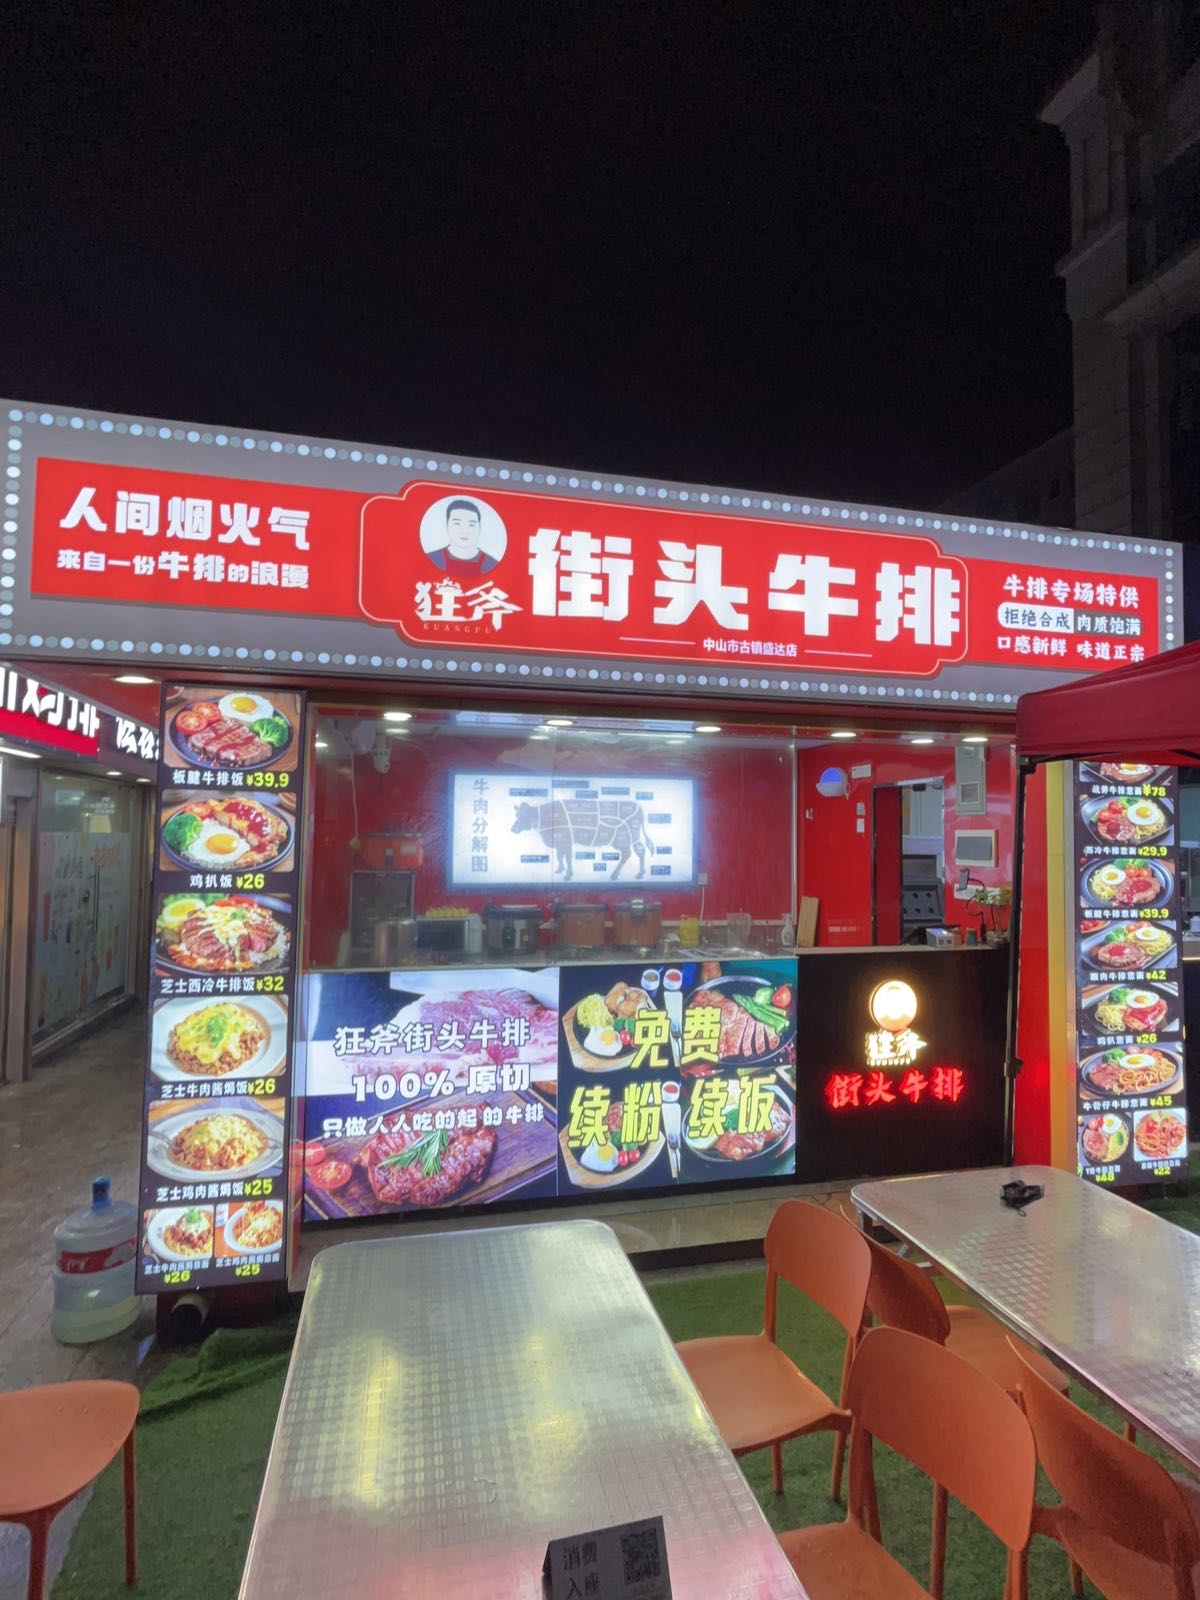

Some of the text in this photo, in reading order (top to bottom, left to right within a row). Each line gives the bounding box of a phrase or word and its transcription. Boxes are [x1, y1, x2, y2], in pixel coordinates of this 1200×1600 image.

[60, 486, 310, 550] 人间烟火气
[57, 549, 309, 589] 来自一份牛排的浪漫
[528, 528, 961, 647] 街头牛排
[1003, 573, 1139, 608] 牛排专场特供
[414, 577, 524, 631] 狂斧
[1004, 607, 1141, 636] 拒绝合成 肉质饱满
[703, 637, 797, 657] 中山市古镇盛达店
[997, 635, 1145, 662] 口感新鲜 味道正宗
[246, 772, 289, 788] ¥39.9
[1143, 783, 1166, 797] ¥78
[472, 778, 489, 872] 牛肉分解图
[1138, 846, 1168, 857] ¥29.9
[190, 873, 265, 889] 鸡扒饭 ¥26
[1139, 908, 1169, 919] ¥39.9
[160, 976, 284, 994] 芝士西冷牛排饭 ¥32
[334, 1017, 531, 1056] 狂斧街头牛排
[631, 1006, 722, 1069] 免费
[1136, 1033, 1157, 1044] ¥26
[161, 1078, 276, 1099] 芝士牛肉酱焗饭 ¥26
[352, 1063, 531, 1102] 100% 原切
[825, 1067, 964, 1109] 街头牛排
[322, 1102, 544, 1138] 只做人人吃的起的牛排
[568, 1074, 777, 1148] 续粉 续饭
[156, 1179, 273, 1202] 芝士鸡肉酱焗饭 ¥25
